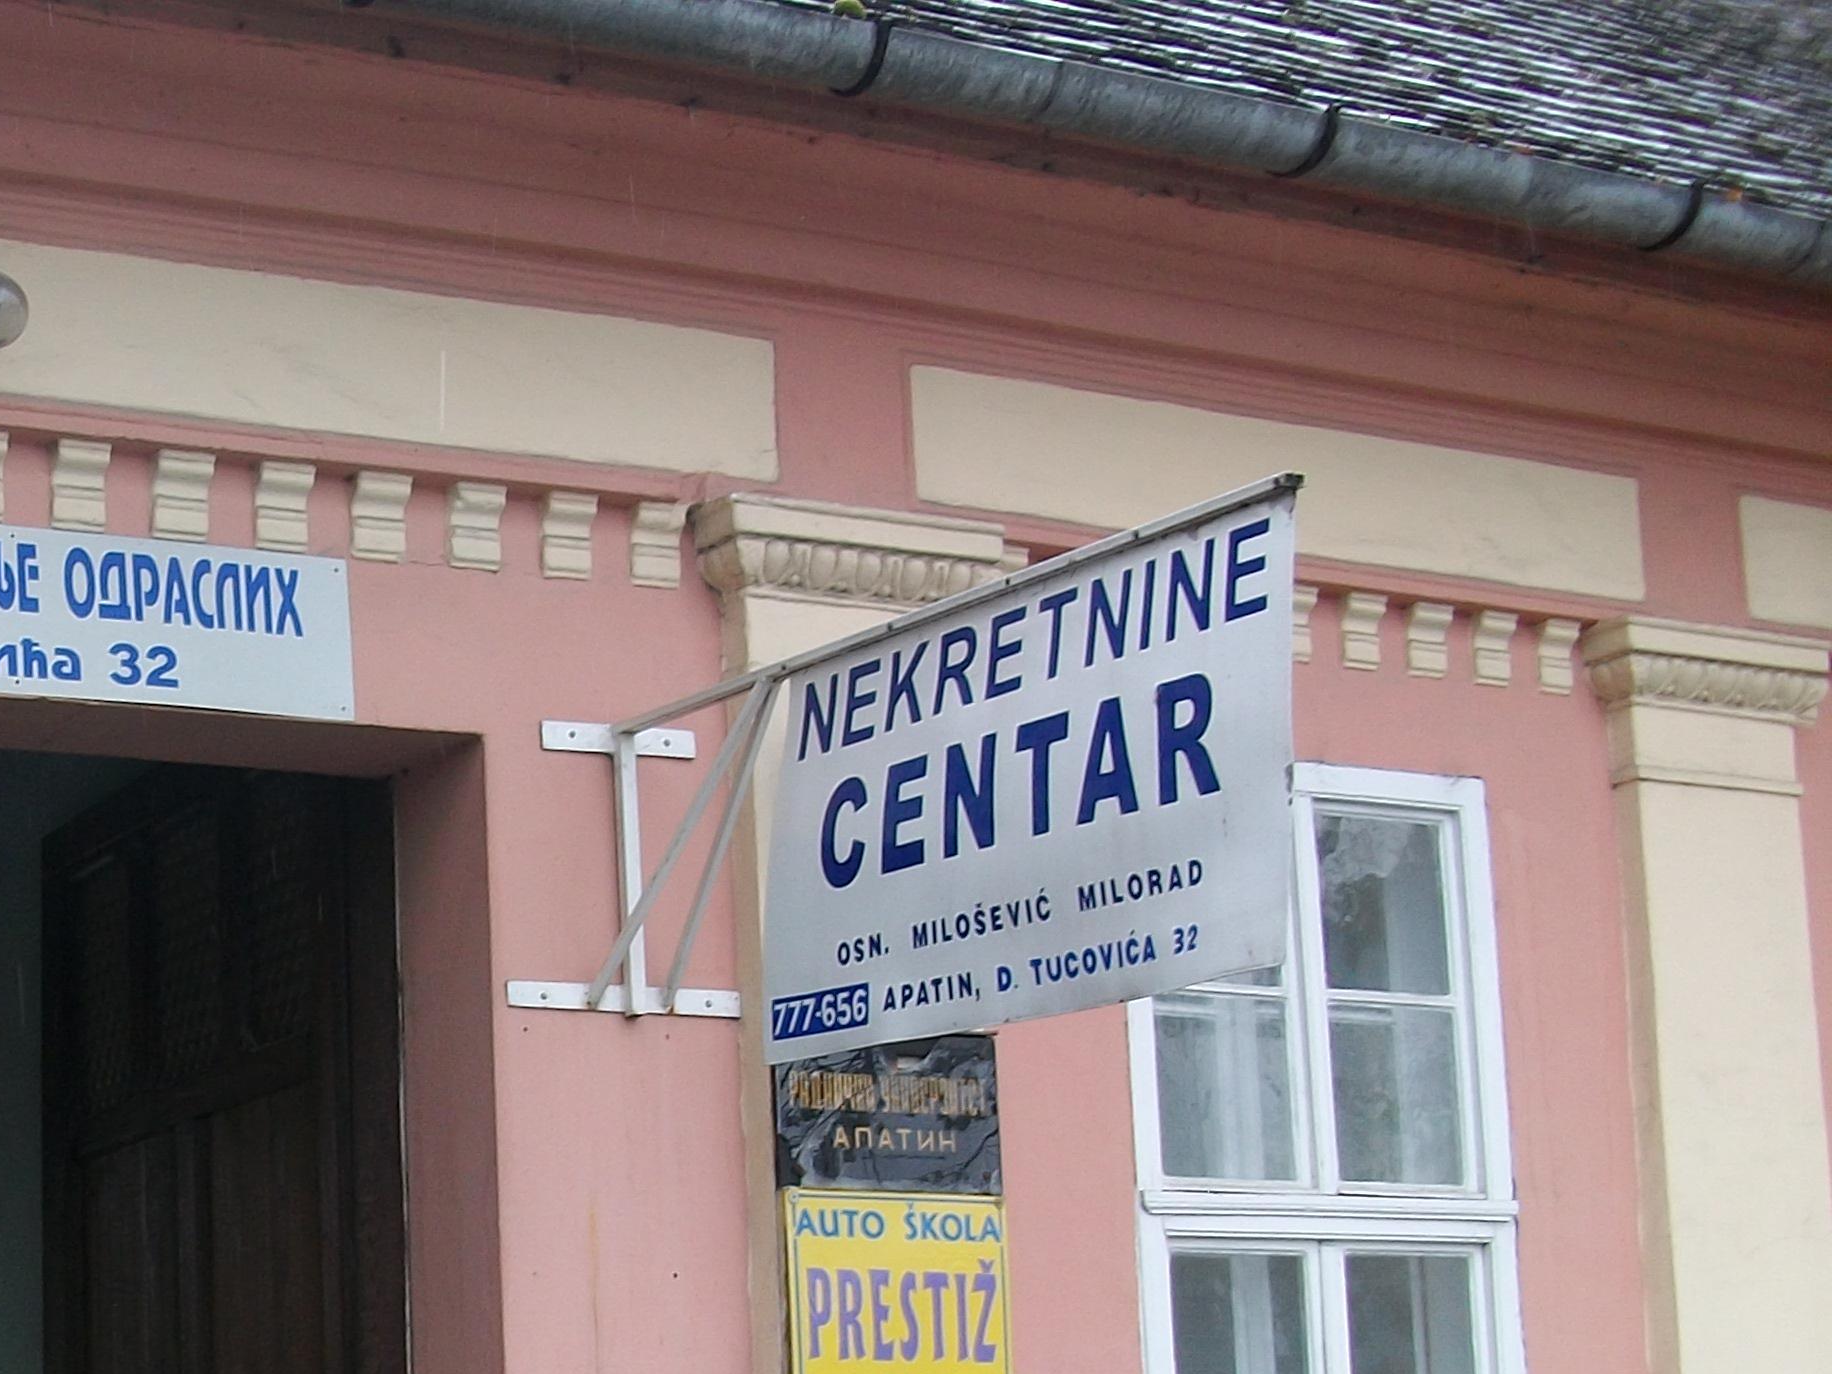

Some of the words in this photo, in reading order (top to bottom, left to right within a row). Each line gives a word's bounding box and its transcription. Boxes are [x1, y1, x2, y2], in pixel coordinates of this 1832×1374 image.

[63, 547, 303, 637] ОДРАСЛИХ
[798, 517, 1270, 762] NEKRETNINE
[109, 642, 180, 689] 32
[820, 672, 1221, 889] CENTAR
[837, 932, 889, 966] OSN.
[912, 888, 1052, 950] MILOŠEVIĆ
[1078, 859, 1203, 912] MILORAD
[774, 988, 868, 1036] 777-656
[883, 972, 980, 1012] APATIN,
[997, 966, 1018, 992] D.
[1029, 929, 1157, 986] TUCOVIĆA
[1173, 924, 1200, 954] 32
[833, 1124, 957, 1153] АПАТИН
[795, 1208, 885, 1240] AUTO
[904, 1200, 1001, 1244] ŠKOLA
[806, 1258, 998, 1364] PRESTIŽ
